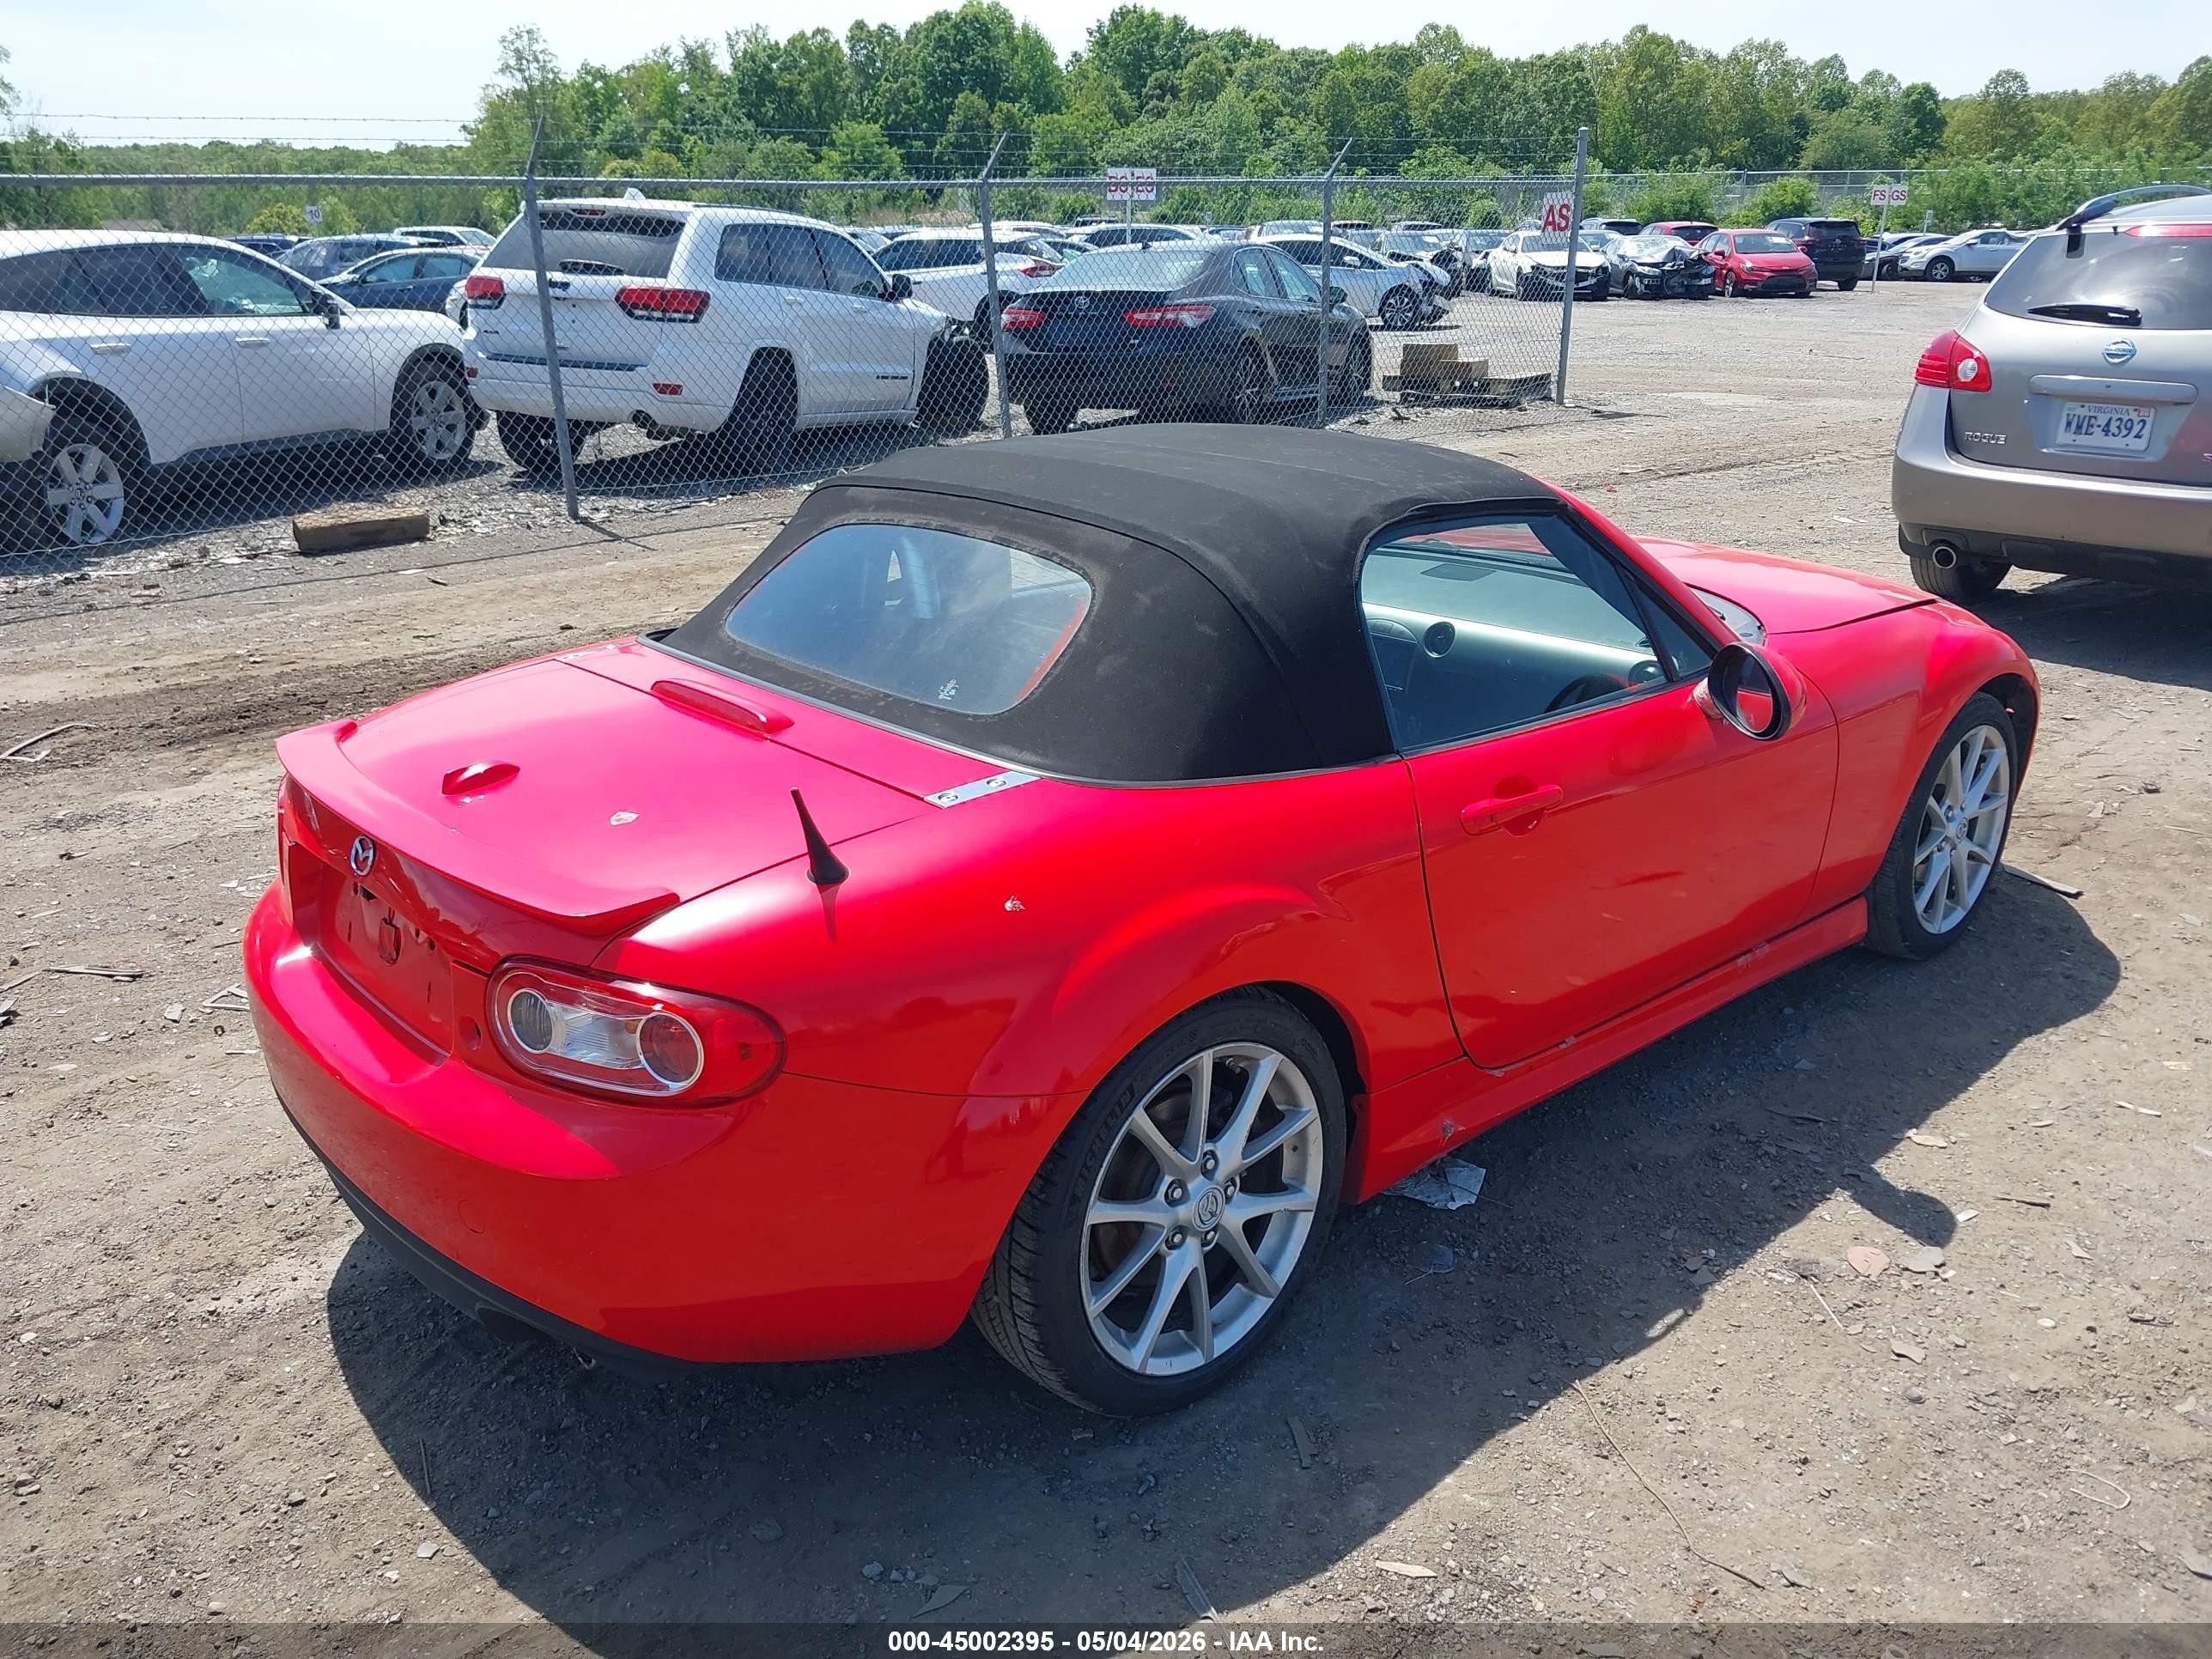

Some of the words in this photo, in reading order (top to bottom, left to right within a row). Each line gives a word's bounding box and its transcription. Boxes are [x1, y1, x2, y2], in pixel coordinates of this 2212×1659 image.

[1873, 189, 1887, 201] FS
[1891, 189, 1907, 201] GS
[1541, 204, 1571, 233] AS
[2087, 404, 2130, 416] VIRGINIA
